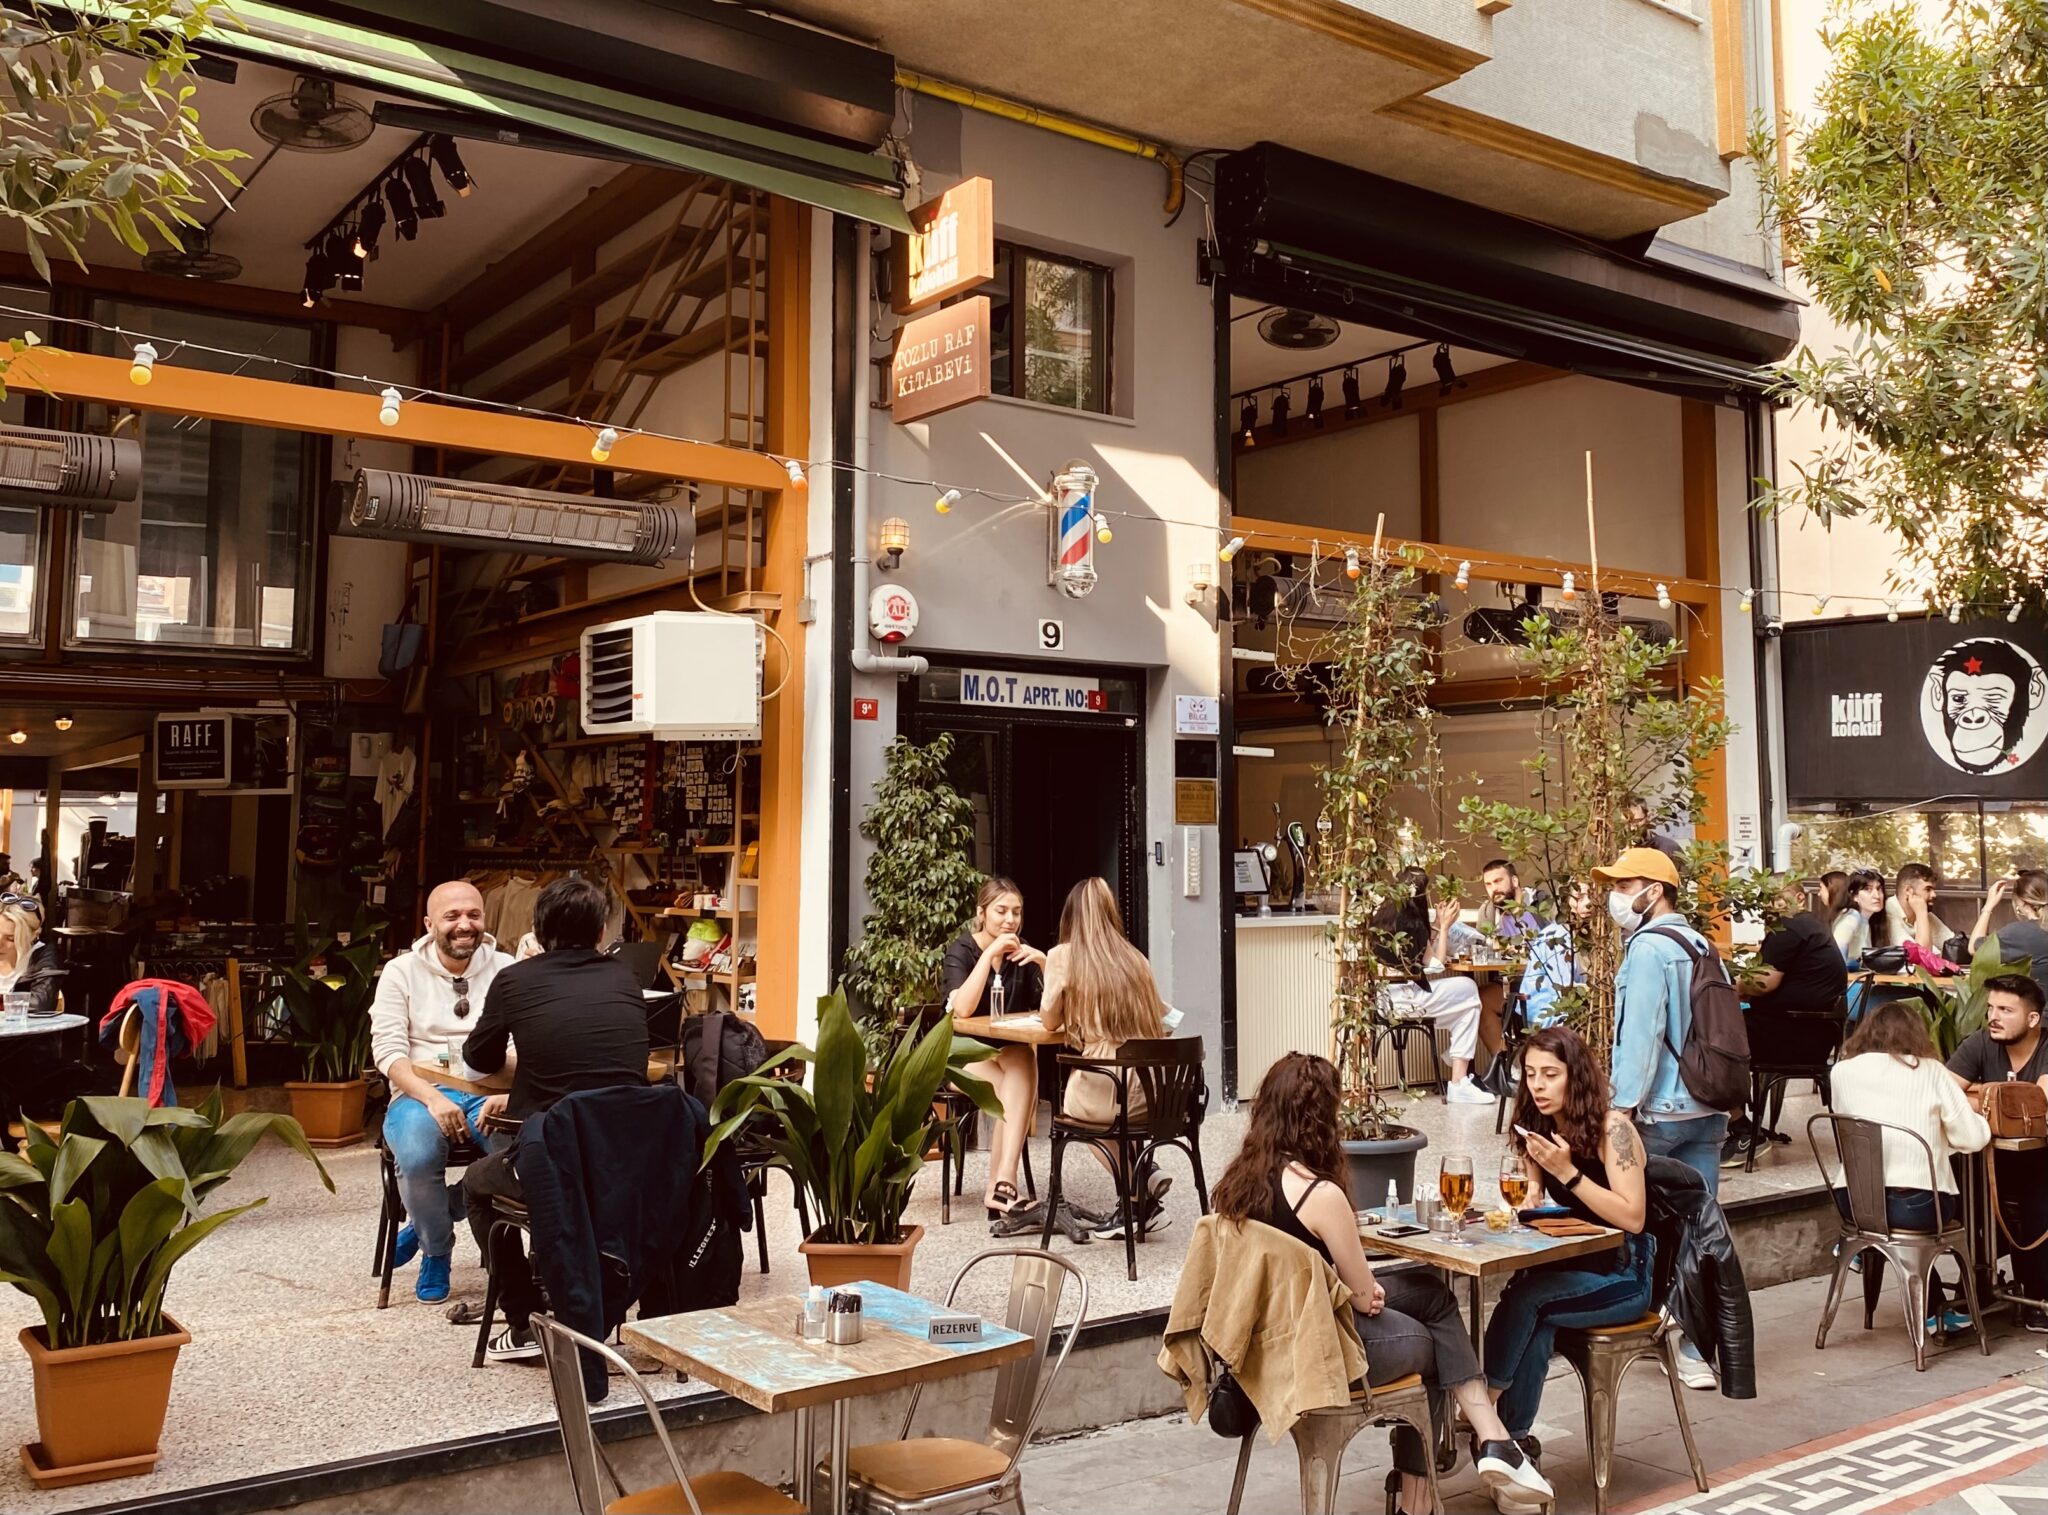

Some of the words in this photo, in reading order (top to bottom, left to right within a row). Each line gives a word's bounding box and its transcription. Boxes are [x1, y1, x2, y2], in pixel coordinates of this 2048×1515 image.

[896, 338, 938, 371] TOZLU
[944, 324, 975, 354] RAF
[1042, 622, 1061, 648] 9
[964, 674, 1018, 703] M.O.T
[1023, 686, 1061, 706] APRT.
[1065, 689, 1088, 708] NO:
[1831, 692, 1883, 722] küff
[171, 723, 213, 749] RAFF
[1831, 721, 1883, 737] kolektif
[932, 1322, 979, 1335] REZERVE
